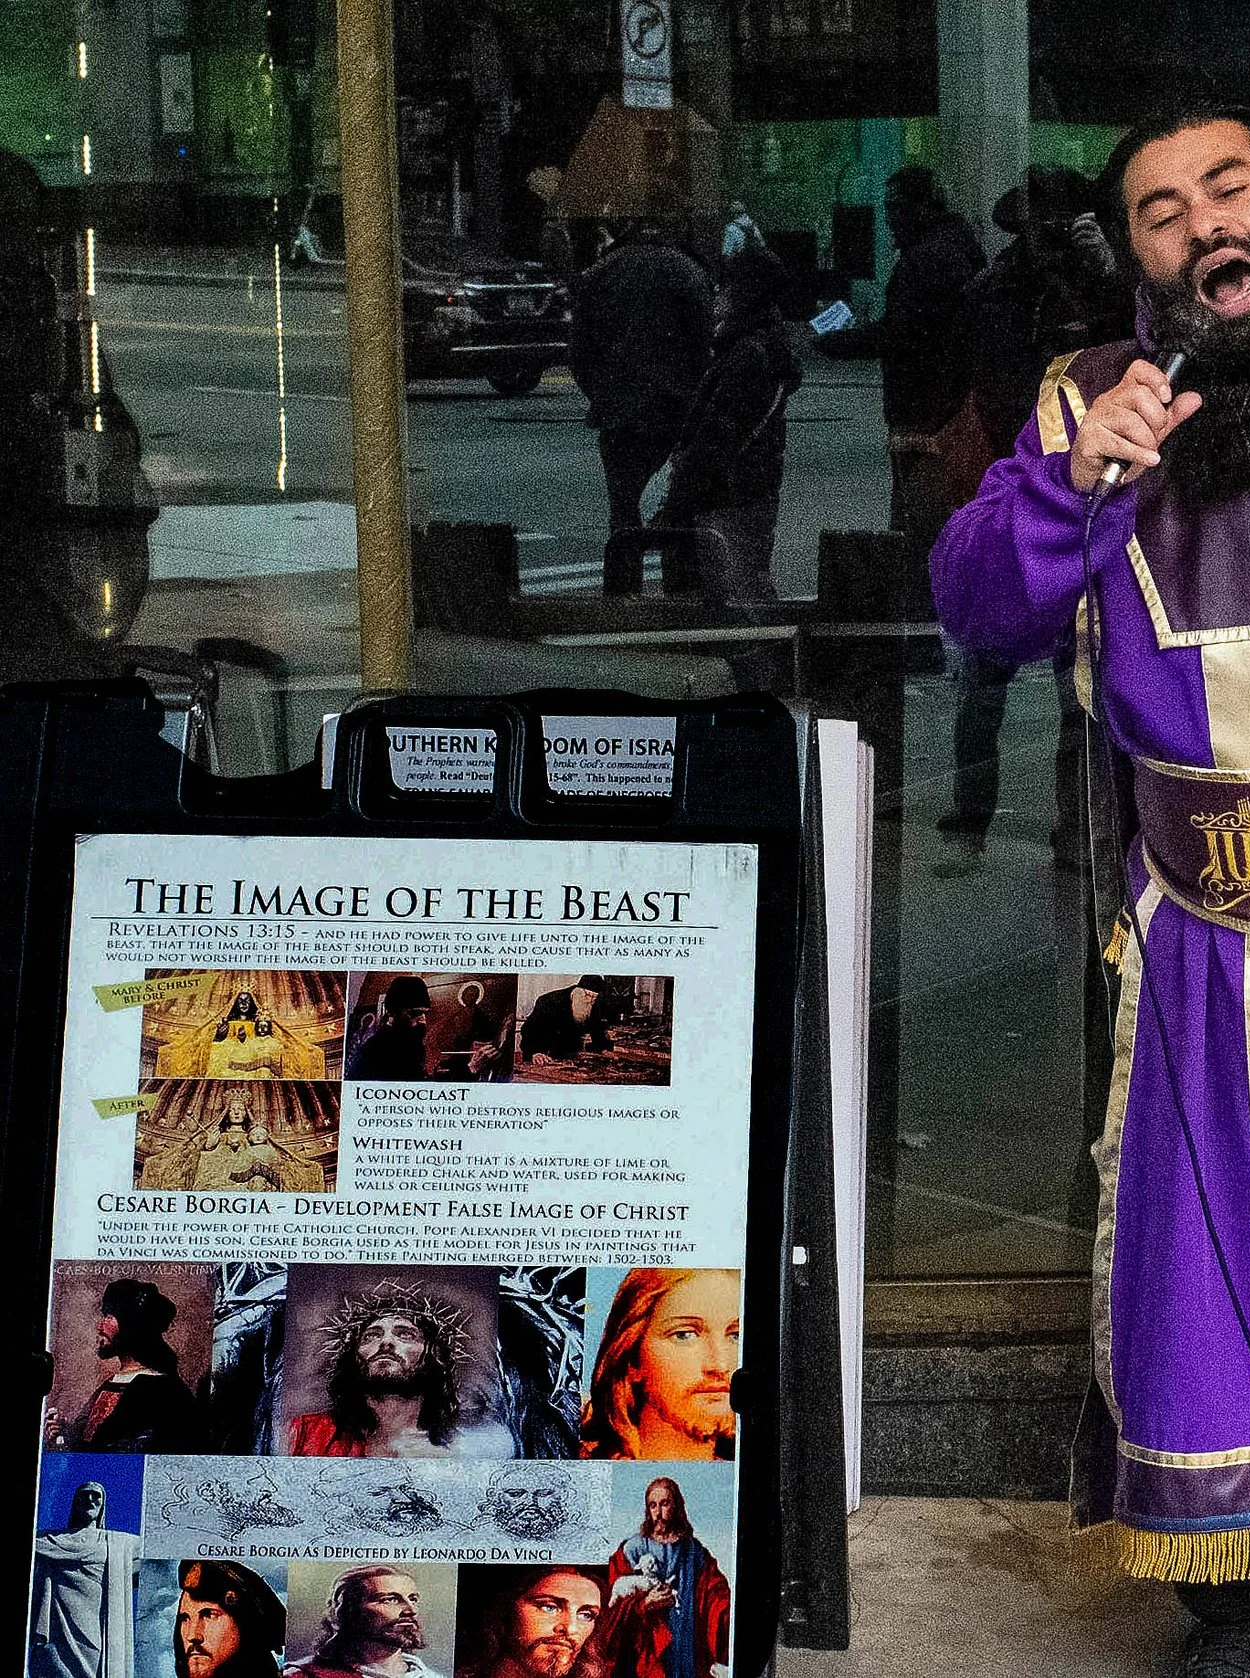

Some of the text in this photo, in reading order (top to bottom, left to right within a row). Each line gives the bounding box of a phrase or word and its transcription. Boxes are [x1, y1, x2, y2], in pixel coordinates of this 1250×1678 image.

[391, 735, 477, 753] UTHERN
[594, 738, 622, 755] OF
[407, 756, 423, 767] The
[440, 771, 464, 780] Read
[586, 773, 605, 783] This
[608, 774, 651, 785] happened
[125, 878, 690, 922] THE IMAGE OF THE BEAST
[355, 1087, 470, 1100] ICONOCLAST
[353, 1137, 462, 1150] WHITEWASH
[97, 1194, 690, 1221] CESARE BORGIA DEVELOPMENT FALSE IMAGE OF CHRIST
[198, 1542, 552, 1562] CESARE BORGIA AS DEPICTED BY LEONARDO DA VINCI
